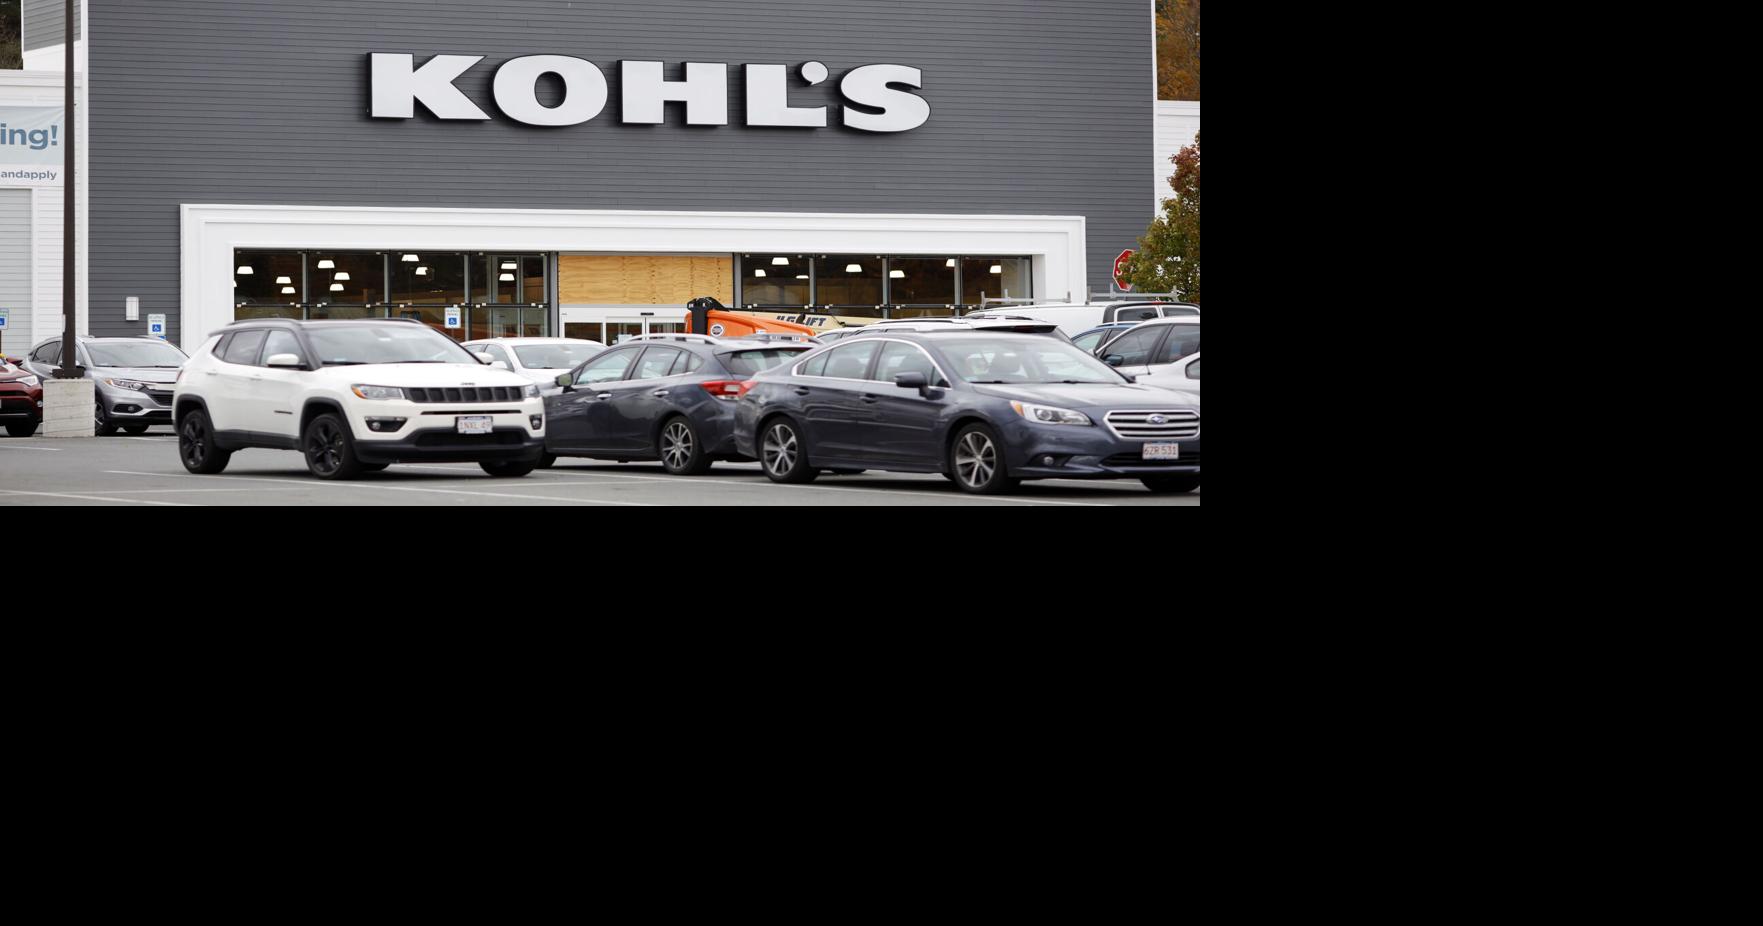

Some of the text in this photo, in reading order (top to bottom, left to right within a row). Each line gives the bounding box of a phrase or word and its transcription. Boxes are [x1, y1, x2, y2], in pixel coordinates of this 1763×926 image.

[370, 52, 932, 133] KOHL'S
[0, 123, 58, 150] ing!
[0, 169, 57, 181] andapply
